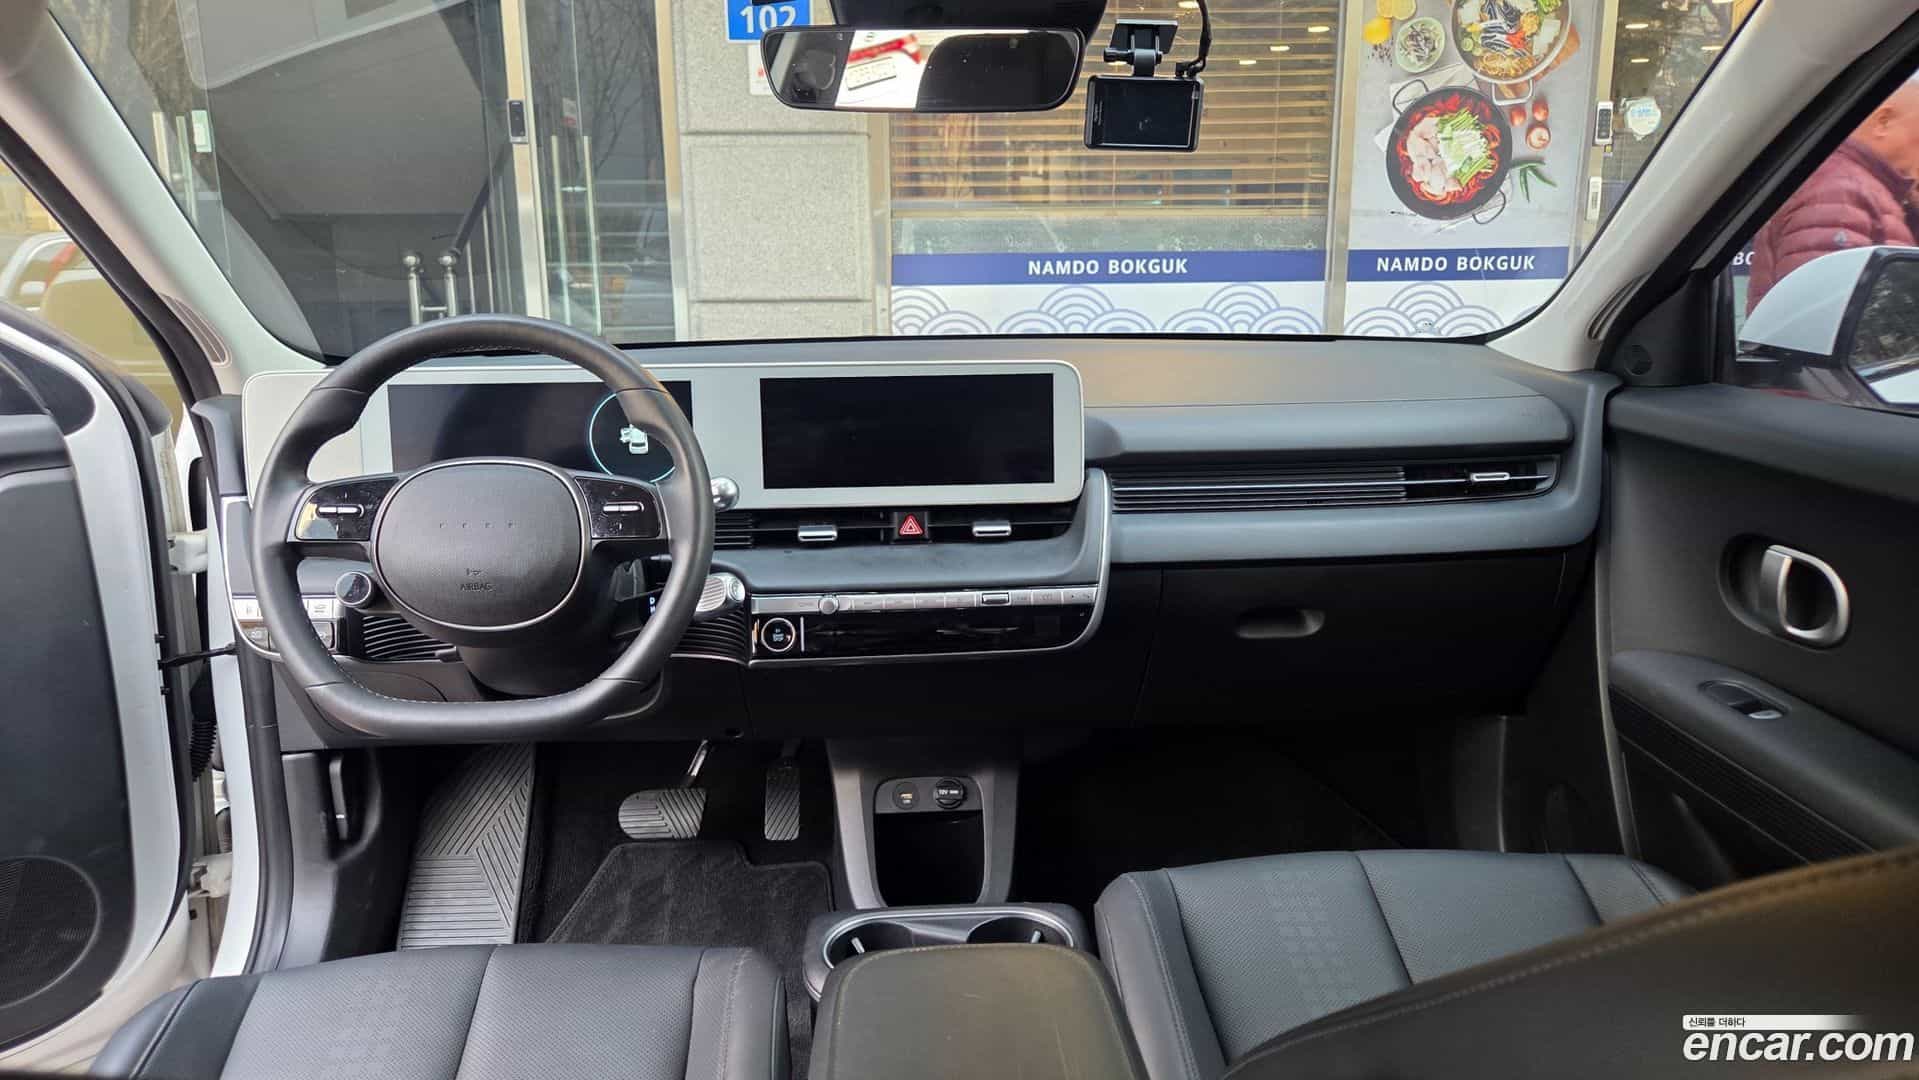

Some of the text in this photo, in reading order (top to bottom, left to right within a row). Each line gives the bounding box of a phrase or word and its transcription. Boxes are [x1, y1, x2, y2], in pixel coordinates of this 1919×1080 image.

[740, 5, 797, 33] 102
[1028, 258, 1188, 276] NAMDO BOKGUK
[1376, 255, 1536, 272] NAMDO BOKGUK
